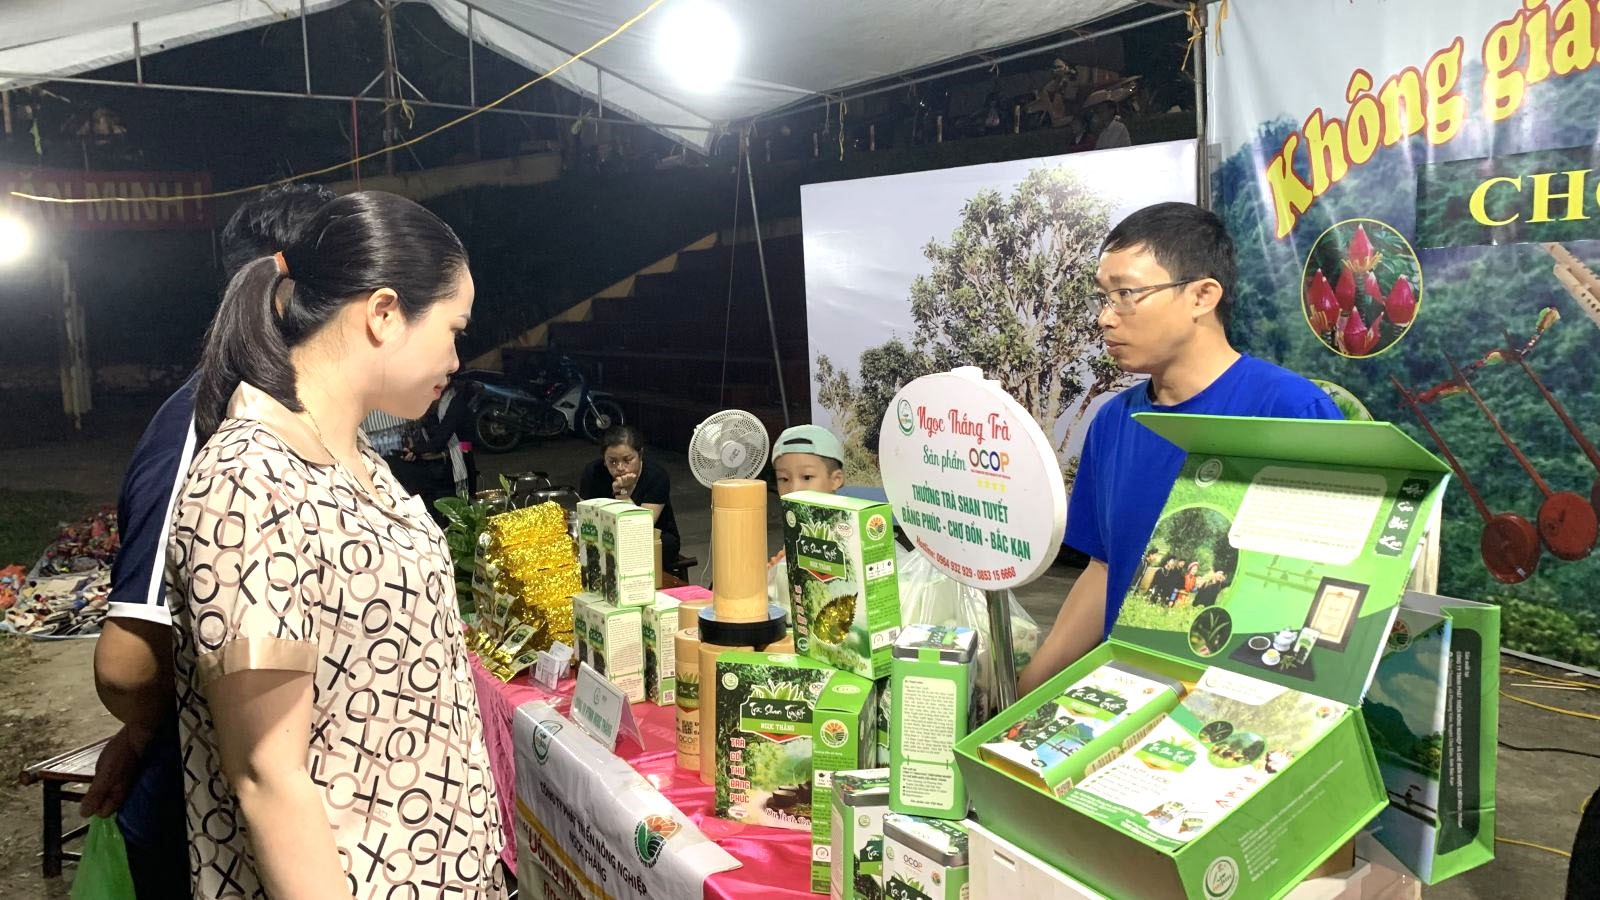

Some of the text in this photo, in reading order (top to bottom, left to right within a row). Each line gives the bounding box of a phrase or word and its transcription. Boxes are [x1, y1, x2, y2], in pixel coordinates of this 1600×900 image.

[1266, 0, 1600, 240] Không gia
[86, 182, 185, 222] MINH
[1468, 168, 1600, 227] CH
[917, 405, 1011, 445] Ngọc Thắng Trà
[923, 445, 1010, 474] Sản phẩm OCOP
[912, 482, 1008, 524] THƯỞNG TRÀ SHAN TUYẾT
[921, 511, 942, 534] PHÚC
[948, 519, 964, 543] CHỢ
[965, 521, 983, 546] ĐỒN
[990, 530, 1009, 556] BẮC
[1010, 540, 1031, 563] KẠN
[936, 552, 950, 569] 0964
[950, 561, 962, 574] 932
[962, 566, 973, 578] 929
[977, 569, 992, 581] 0853
[992, 569, 1000, 581] 15
[596, 839, 616, 870] NÔNG
[618, 861, 648, 896] NGHIỆP
